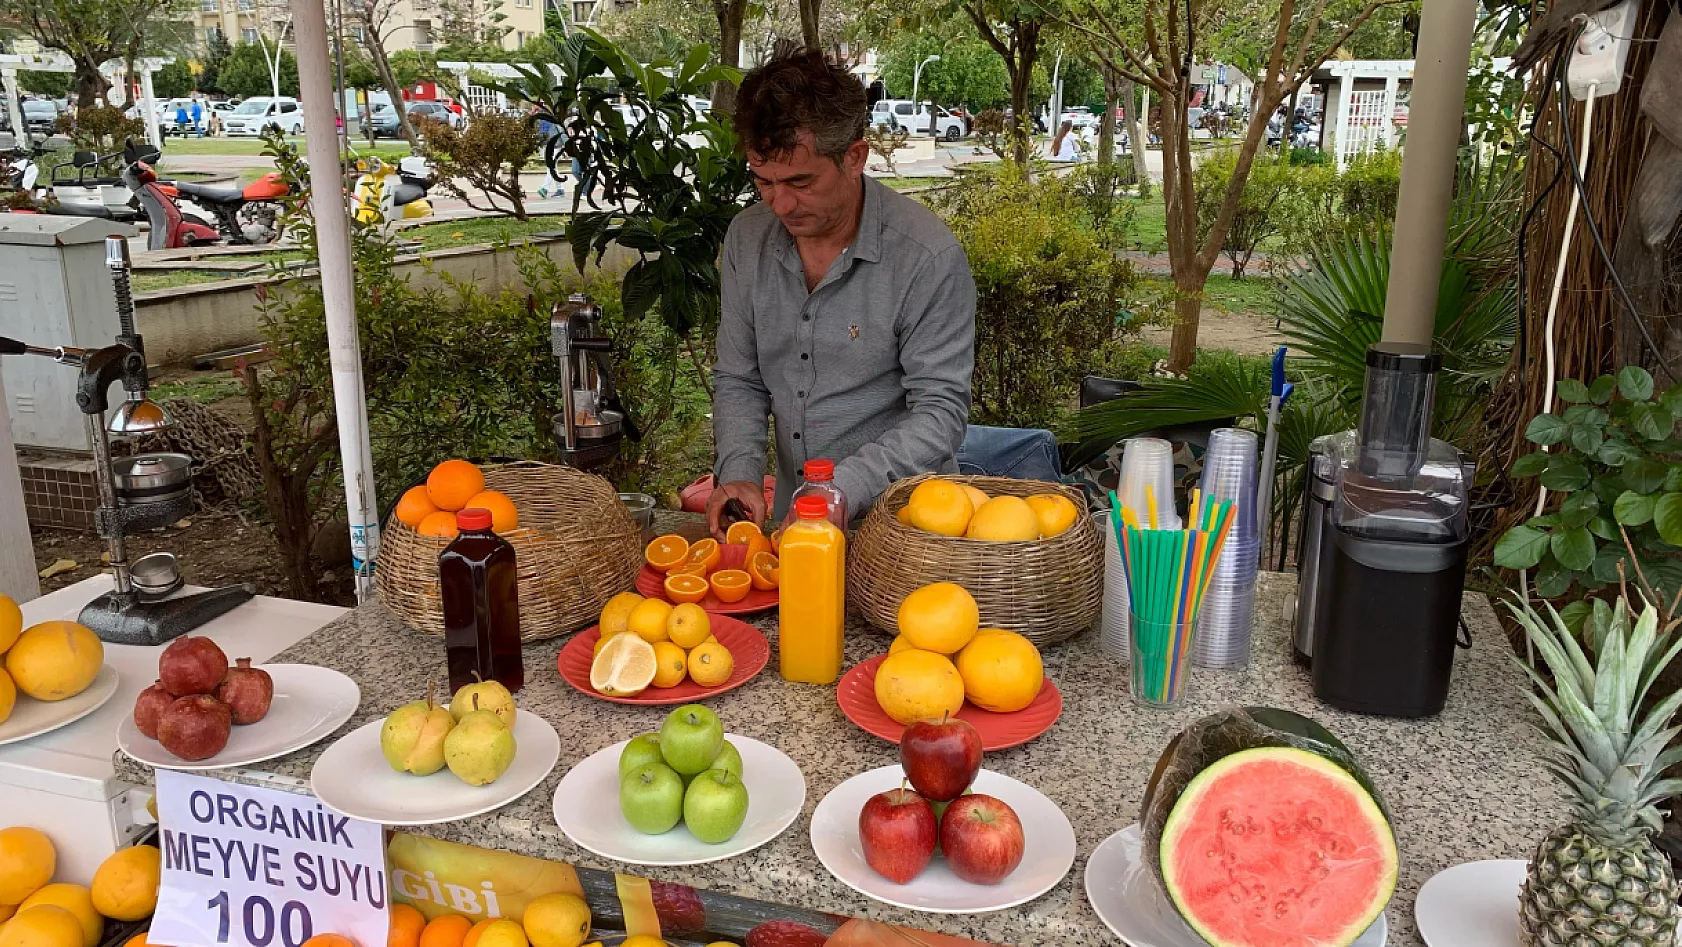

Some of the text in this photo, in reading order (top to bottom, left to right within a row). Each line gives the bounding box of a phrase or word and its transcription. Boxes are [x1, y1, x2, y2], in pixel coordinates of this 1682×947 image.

[190, 790, 354, 849] ORGANİK
[164, 830, 385, 910] MEYVE SUYU
[207, 890, 313, 947] 100
